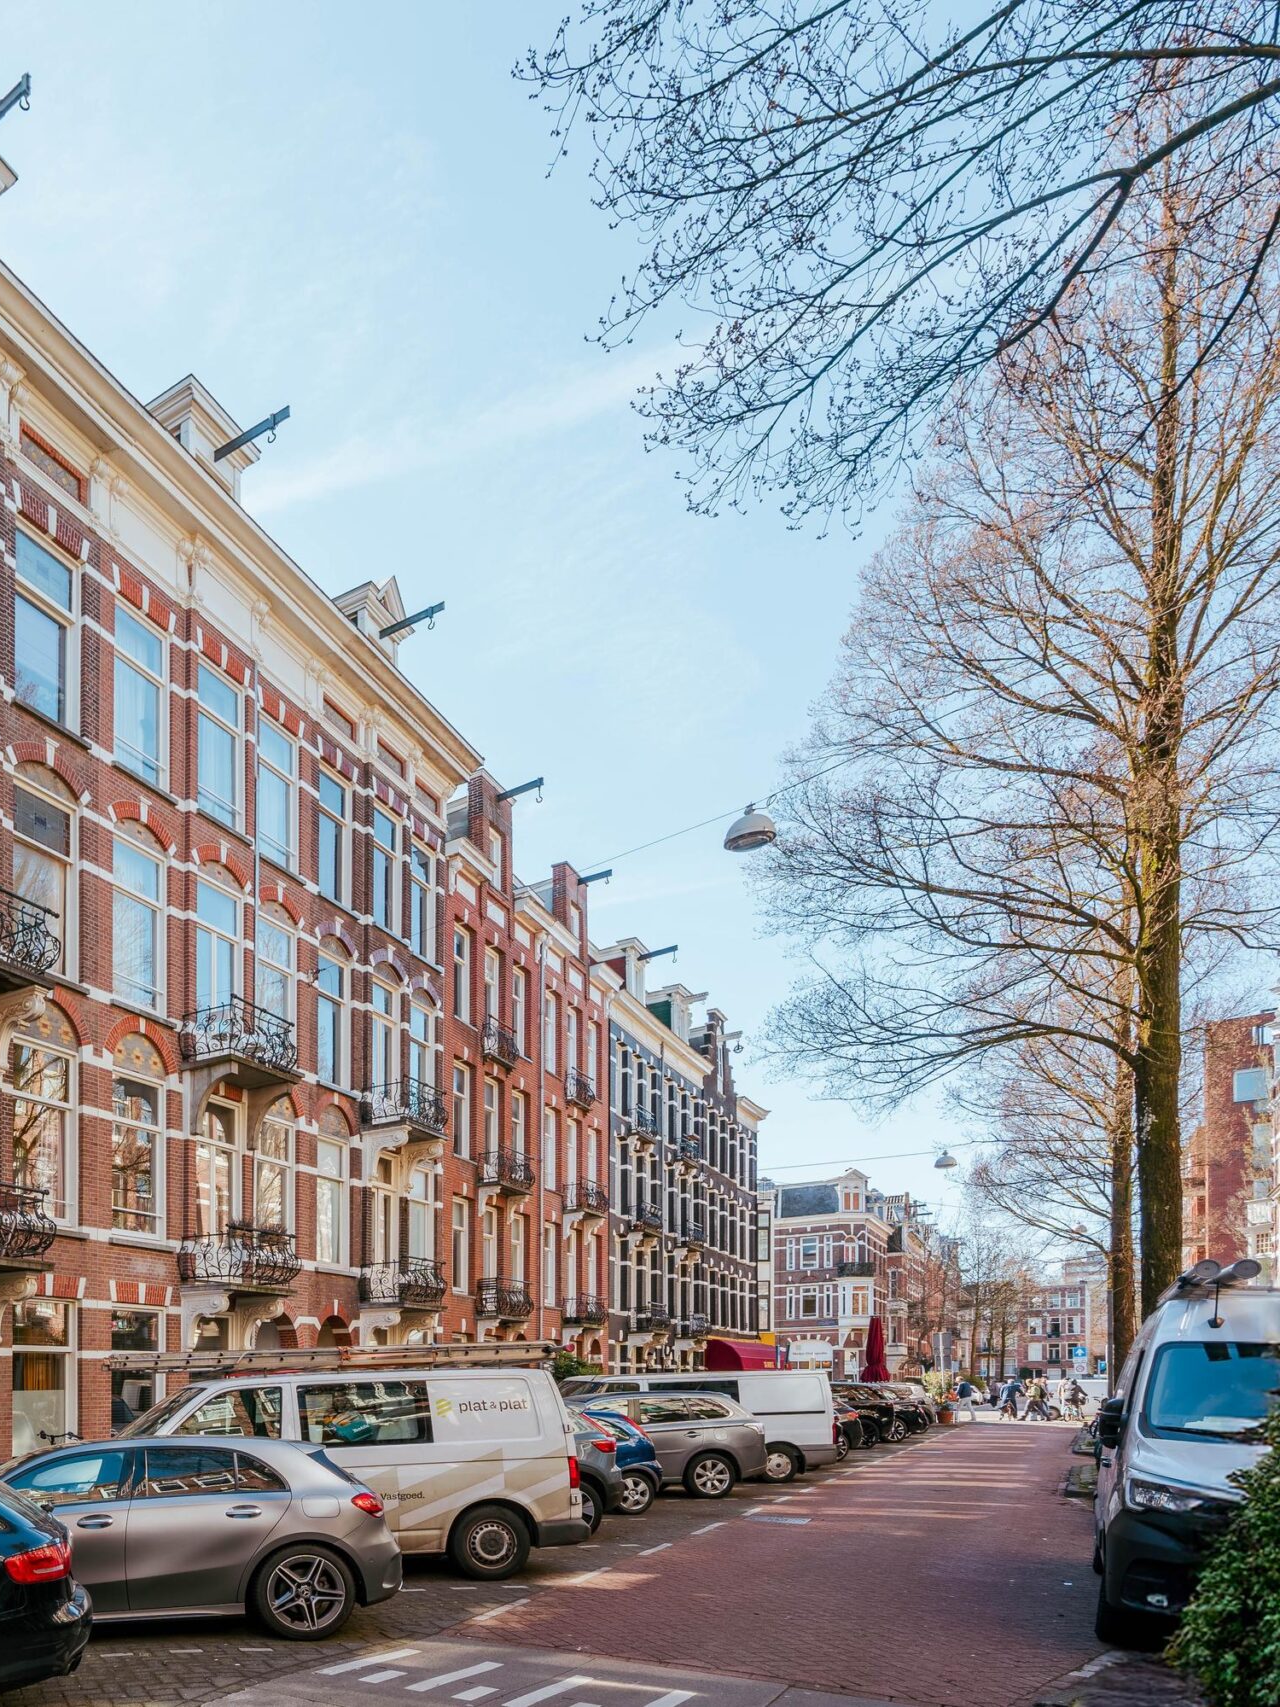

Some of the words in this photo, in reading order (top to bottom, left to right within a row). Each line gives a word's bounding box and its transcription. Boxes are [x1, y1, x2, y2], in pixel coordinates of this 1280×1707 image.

[459, 1400, 488, 1413] plat
[490, 1401, 497, 1410] &
[499, 1399, 528, 1412] plat
[380, 1491, 425, 1501] Vastgoed.
